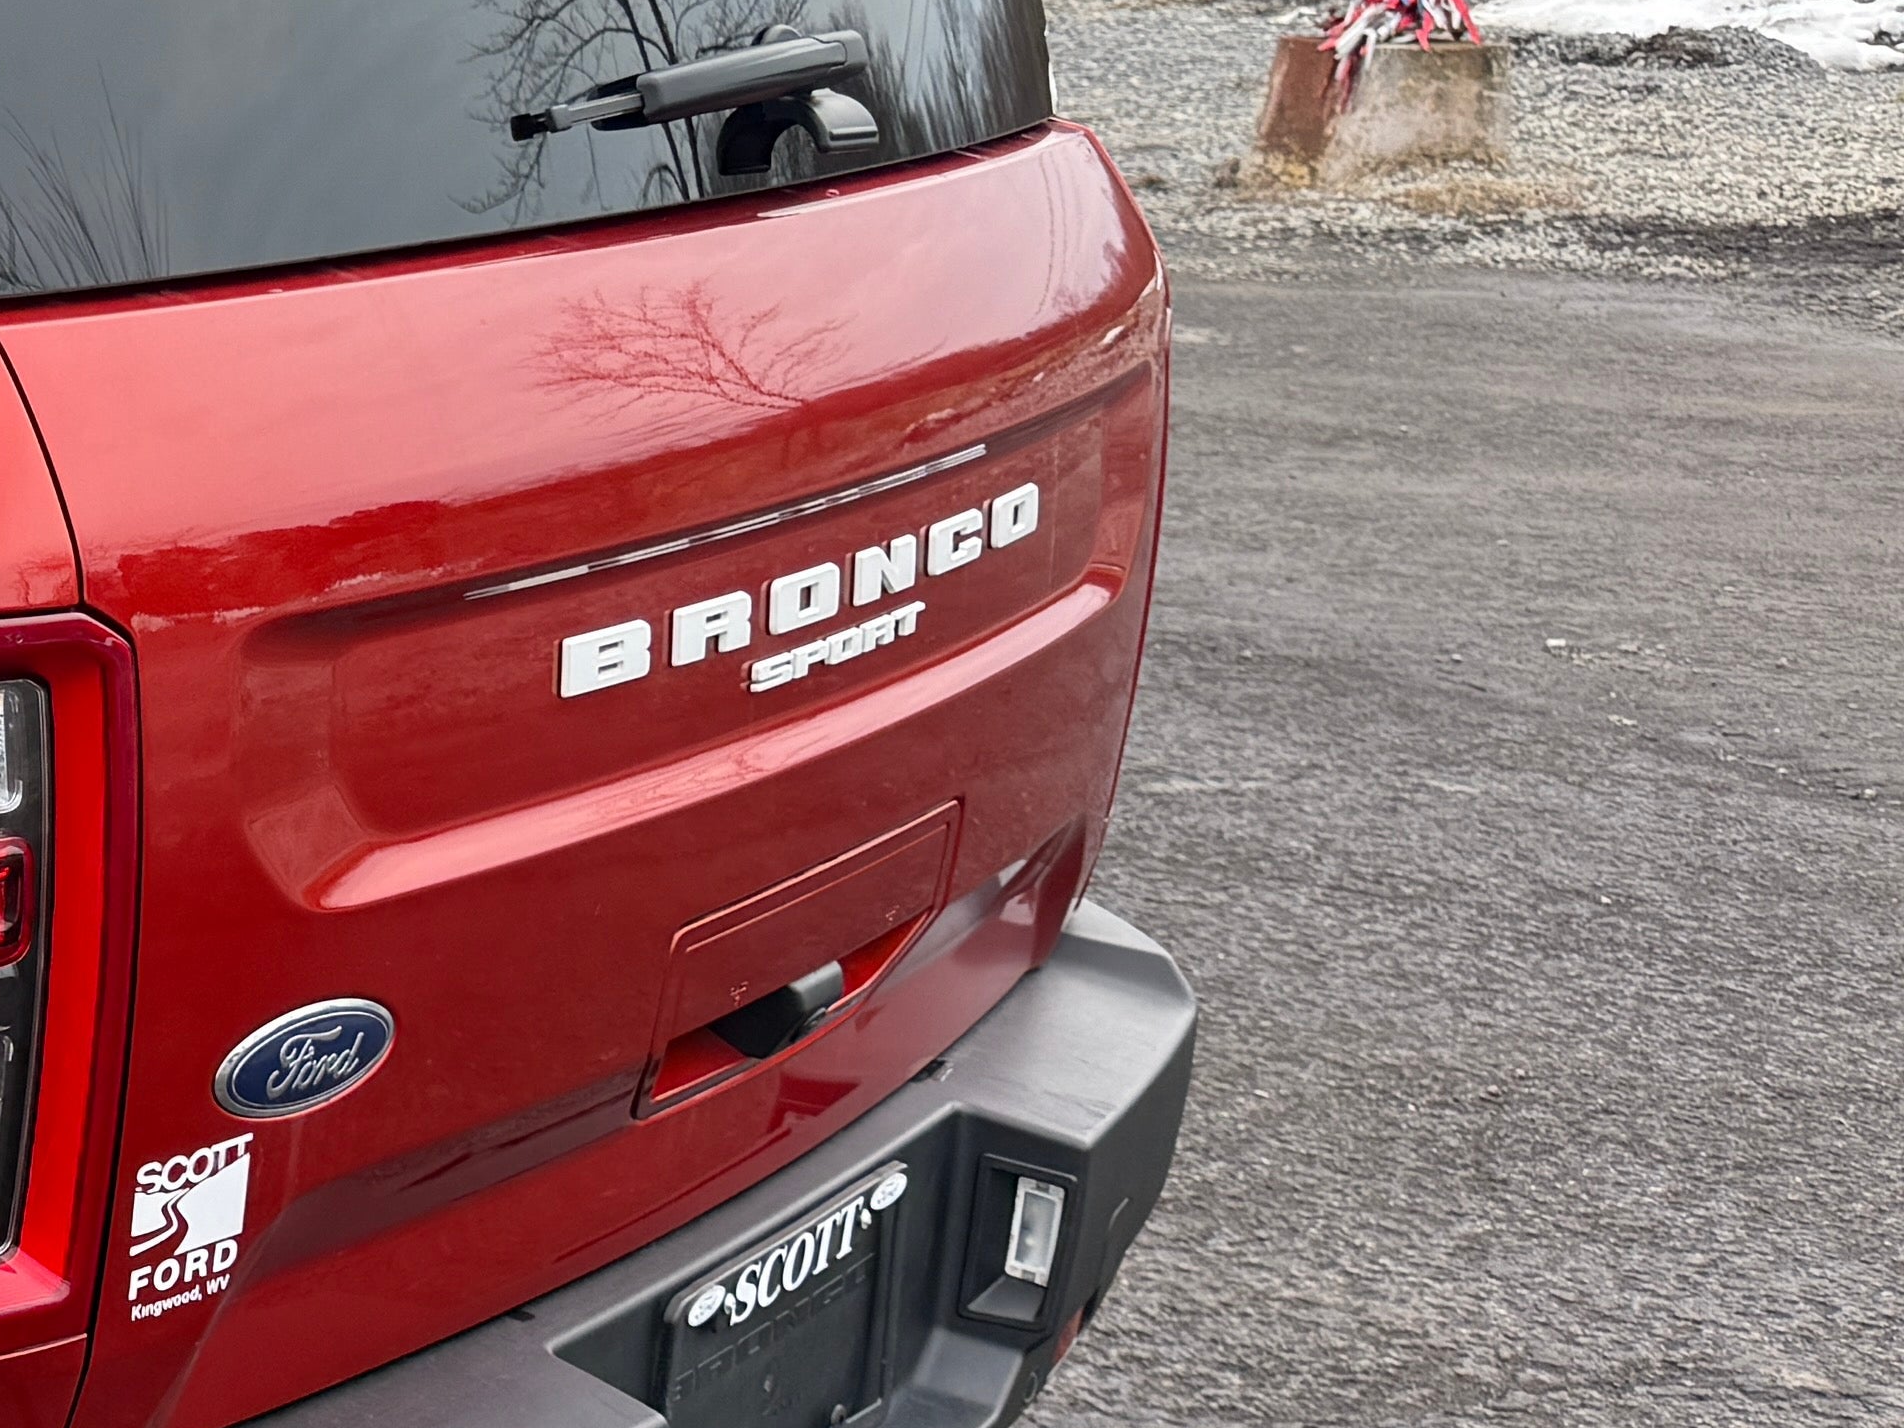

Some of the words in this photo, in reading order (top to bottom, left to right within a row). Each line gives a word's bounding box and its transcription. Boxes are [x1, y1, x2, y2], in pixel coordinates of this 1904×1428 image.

[559, 481, 1039, 699] BRONCO
[748, 599, 927, 693] SPORT
[265, 1024, 365, 1101] Ford
[135, 1131, 254, 1195] SCOTT
[127, 1238, 238, 1301] FORD
[130, 1286, 203, 1322] Kingwood,
[206, 1273, 231, 1297] WV
[725, 1195, 865, 1327] SCOTT
